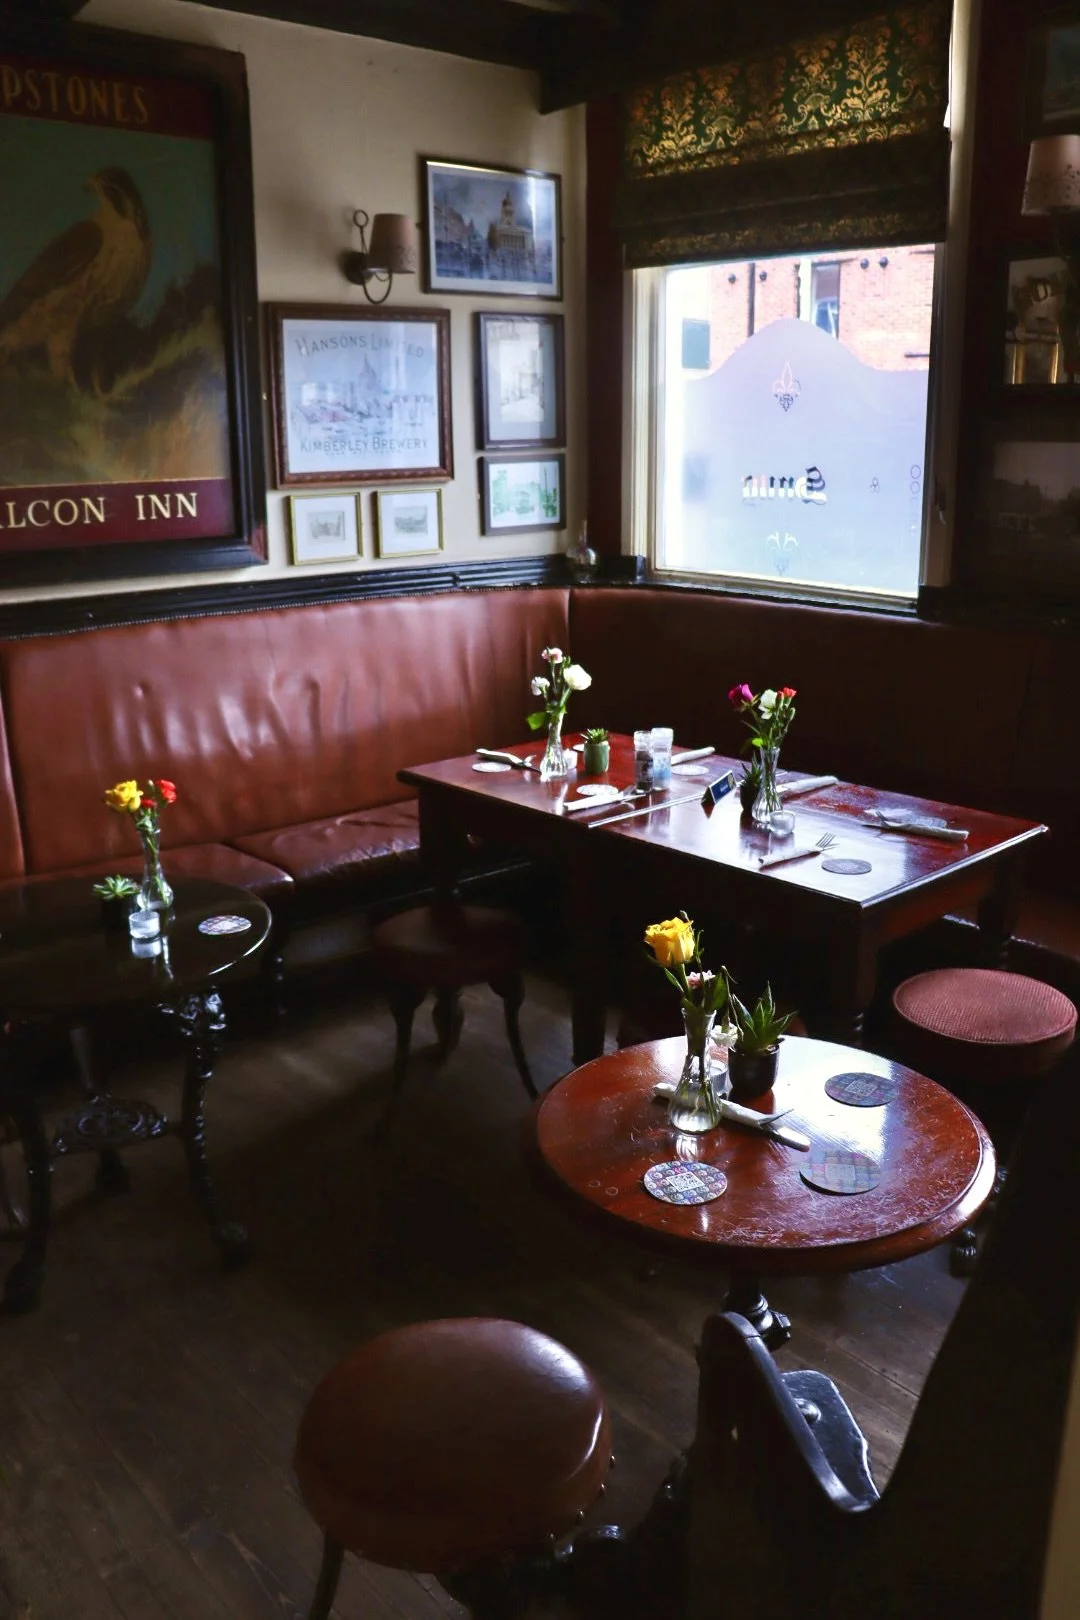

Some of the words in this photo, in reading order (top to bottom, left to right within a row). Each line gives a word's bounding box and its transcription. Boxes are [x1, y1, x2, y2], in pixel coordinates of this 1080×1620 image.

[295, 334, 368, 357] HANSONS
[371, 332, 424, 358] LIMIED
[300, 437, 369, 453] KIMBERLEY
[372, 436, 428, 451] BREWERY
[0, 496, 105, 529] LCON
[135, 492, 198, 521] INN
